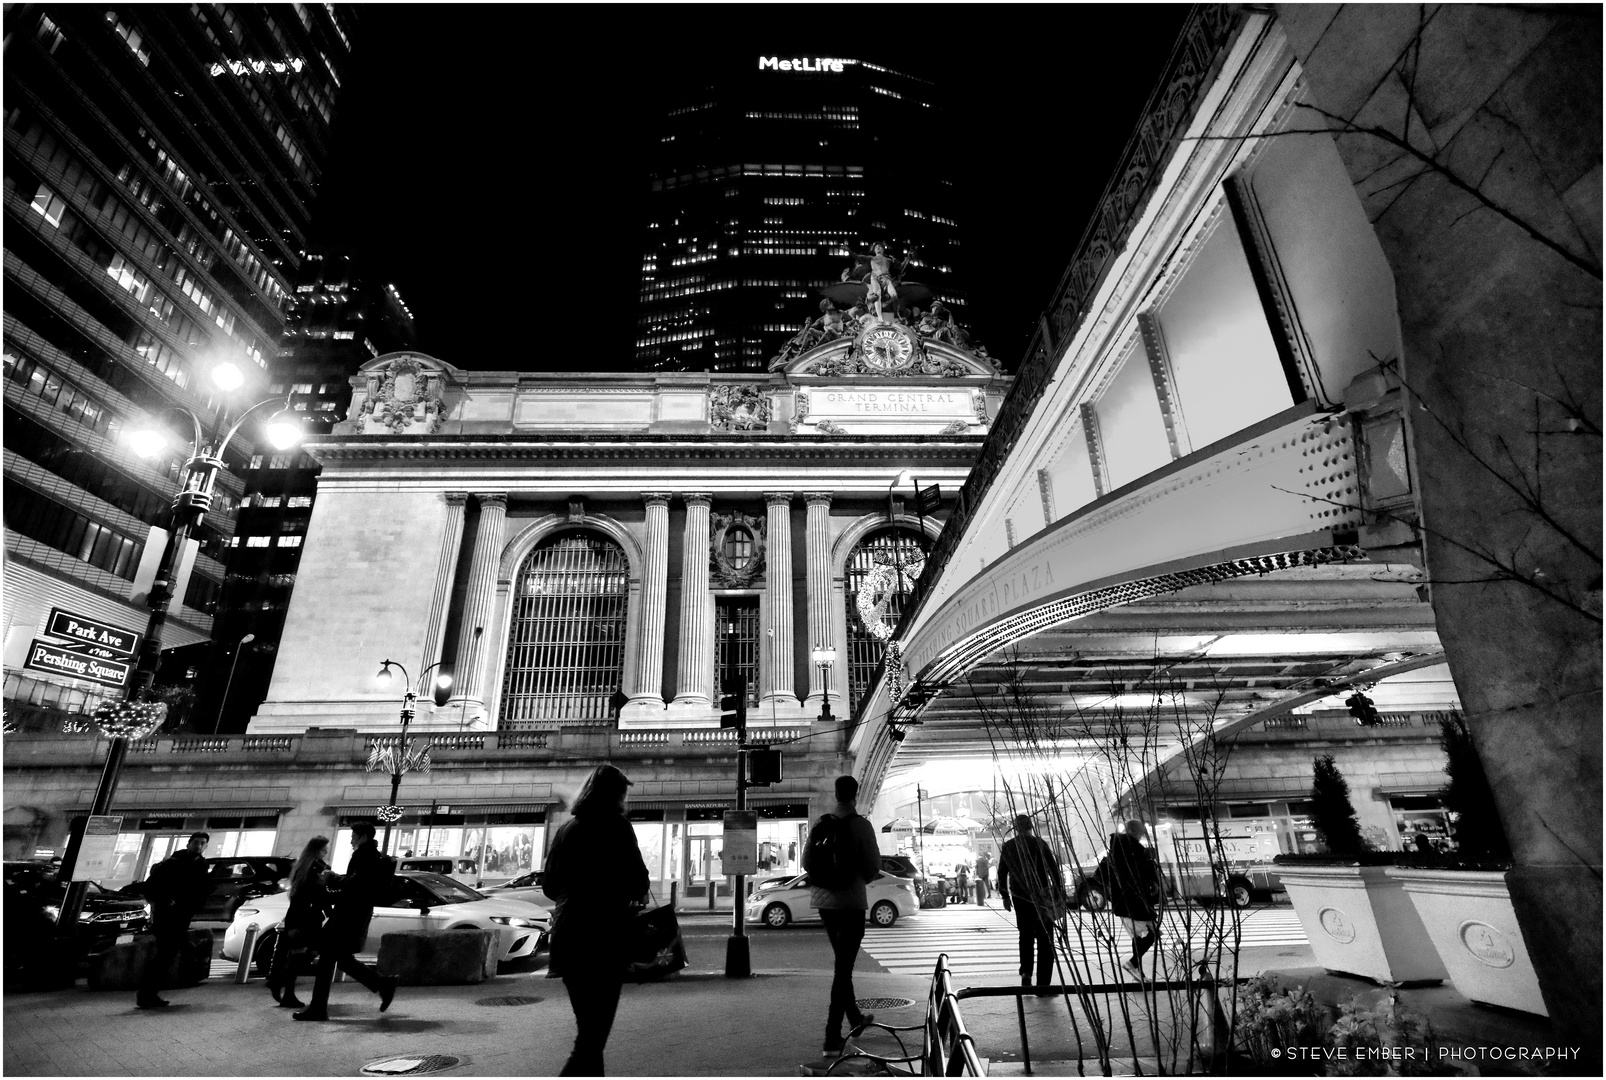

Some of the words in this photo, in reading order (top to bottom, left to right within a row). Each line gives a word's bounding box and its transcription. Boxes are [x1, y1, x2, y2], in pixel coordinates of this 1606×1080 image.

[759, 56, 844, 72] MetLife
[826, 393, 878, 402] GRAND
[887, 393, 954, 403] CENTRAL
[855, 403, 928, 412] TERMINAL
[956, 591, 996, 635] SQUARE
[1003, 560, 1055, 605] PLAZA
[66, 620, 98, 641] Park
[98, 630, 123, 647] Ave
[34, 647, 88, 674] Pershing
[88, 660, 125, 681] Square
